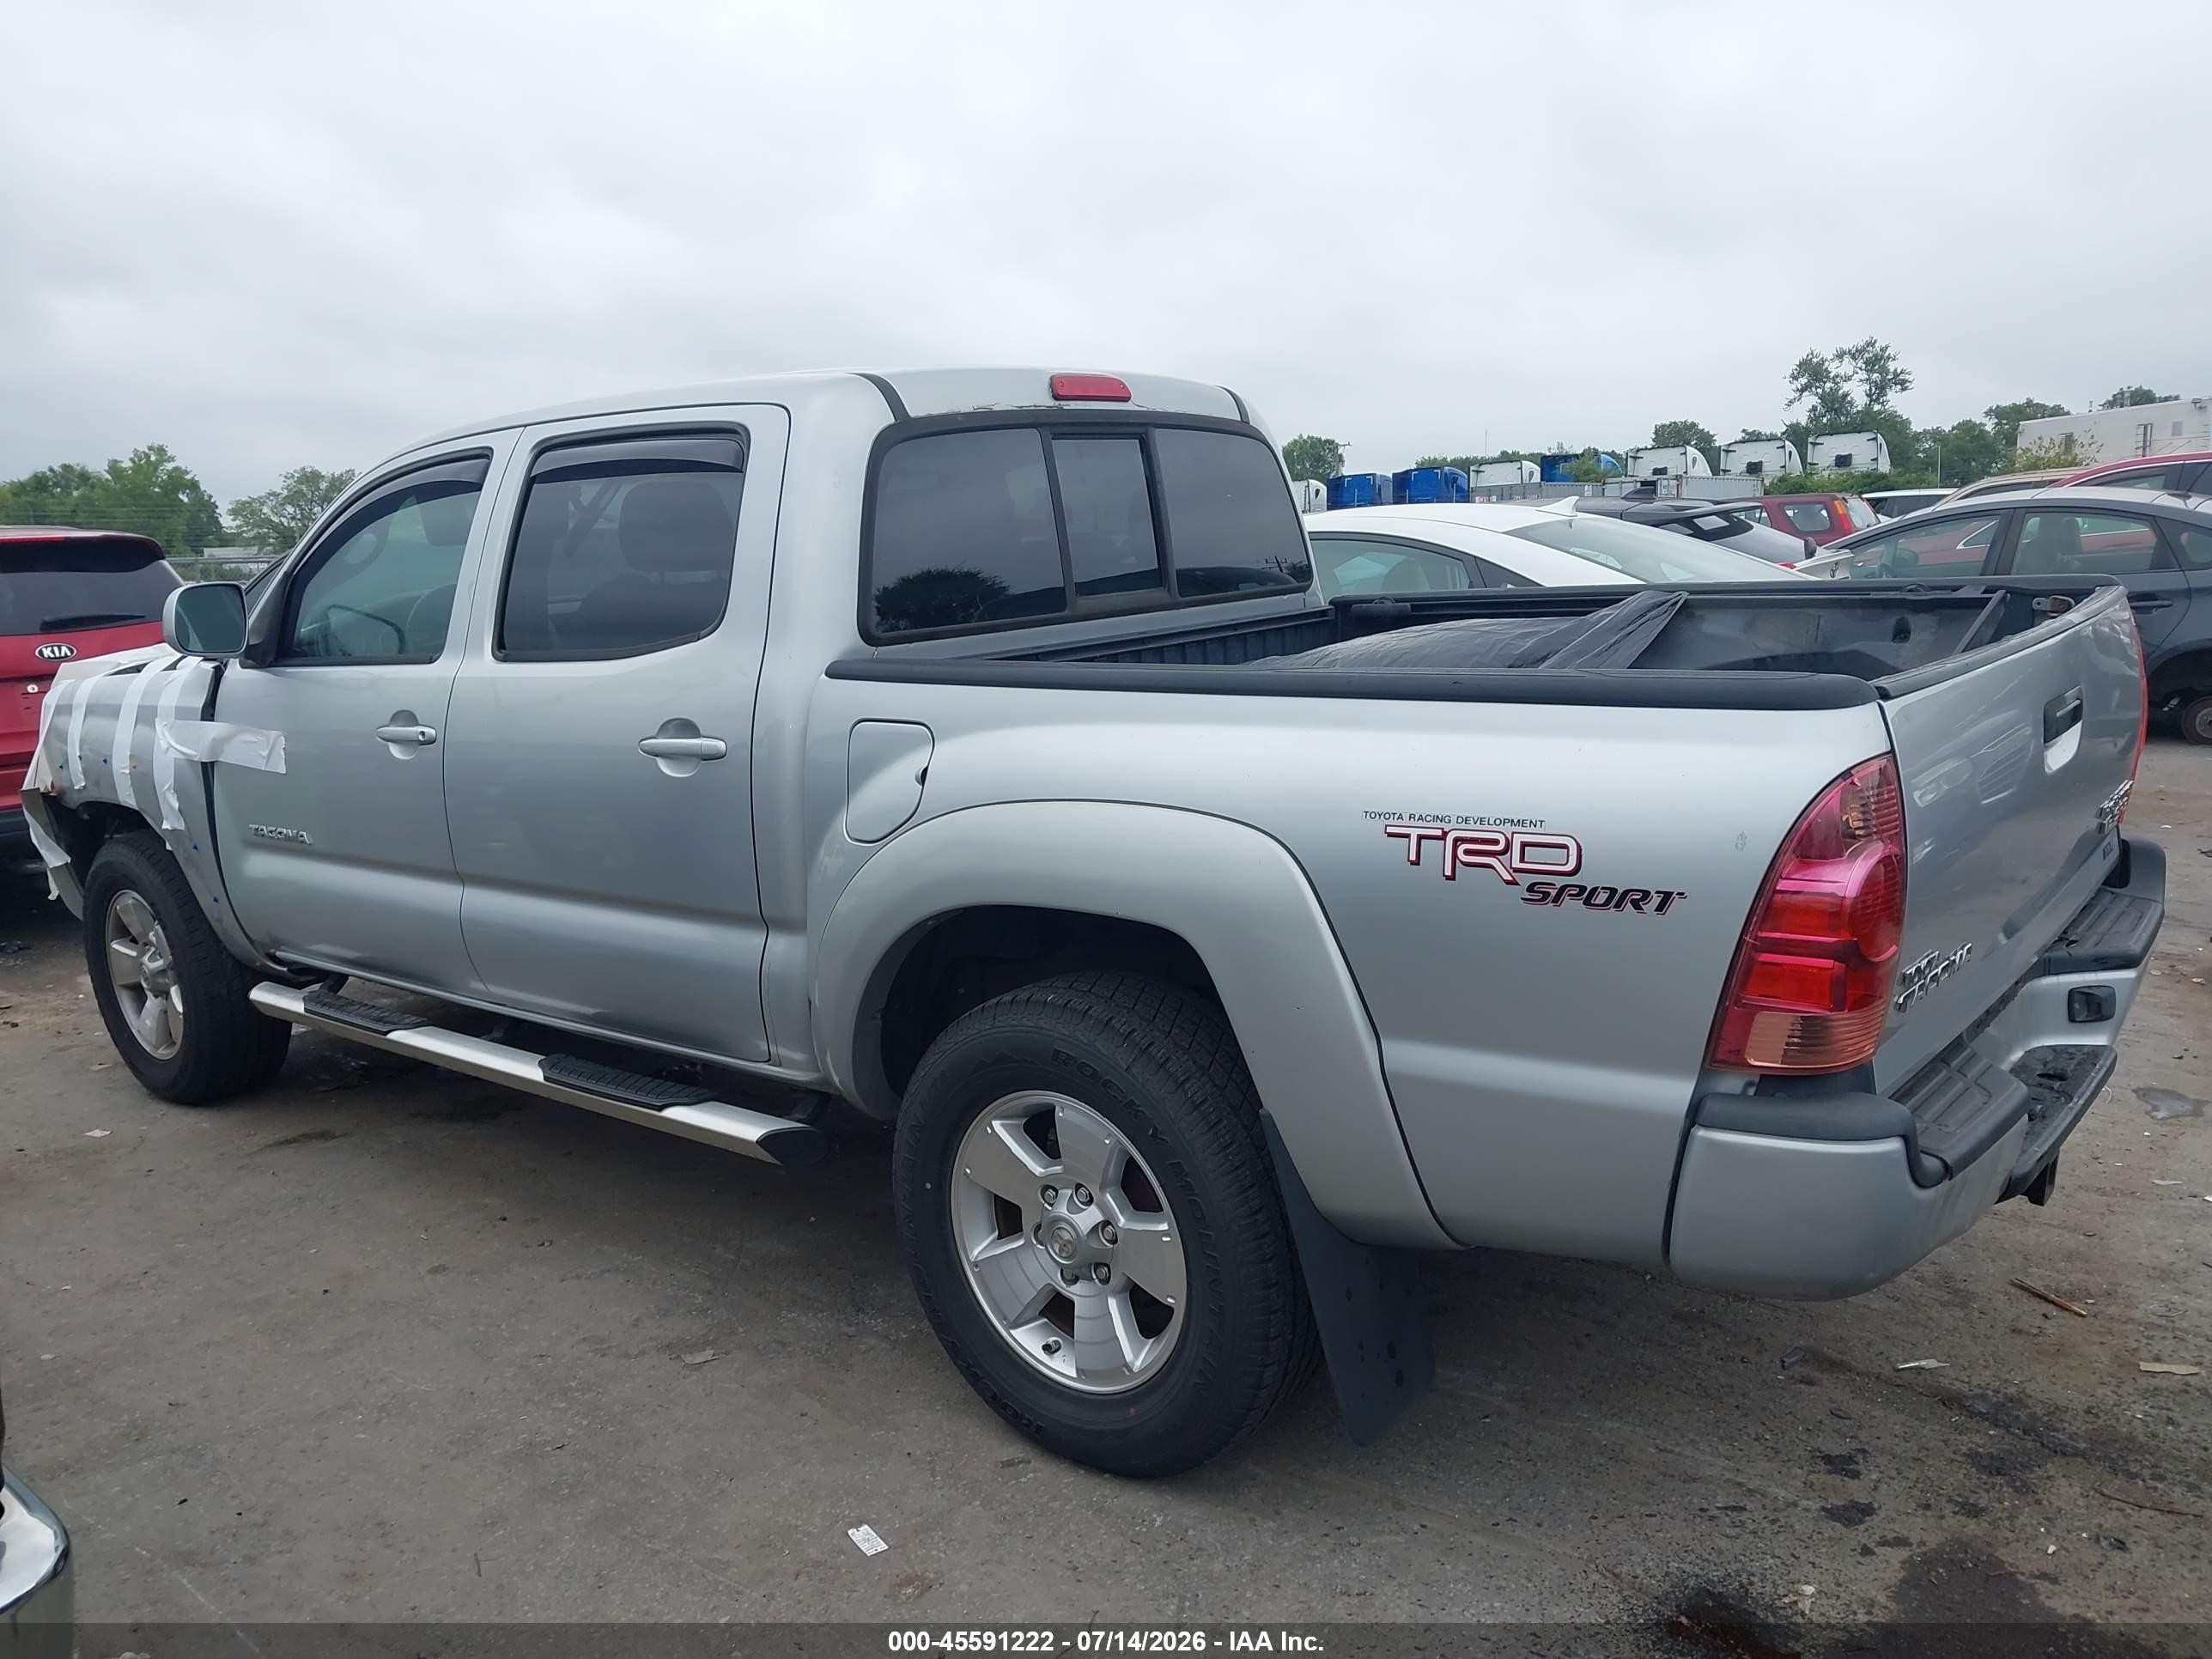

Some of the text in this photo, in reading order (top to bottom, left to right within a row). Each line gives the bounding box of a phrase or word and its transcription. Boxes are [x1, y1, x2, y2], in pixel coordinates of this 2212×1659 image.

[41, 645, 71, 659] KIA
[1363, 811, 1546, 829] TOYOTA RACING DEVELOPMENT
[1385, 824, 1583, 886] TRD
[1520, 882, 1688, 915] SPORT
[1050, 1046, 1175, 1147] ROCKY
